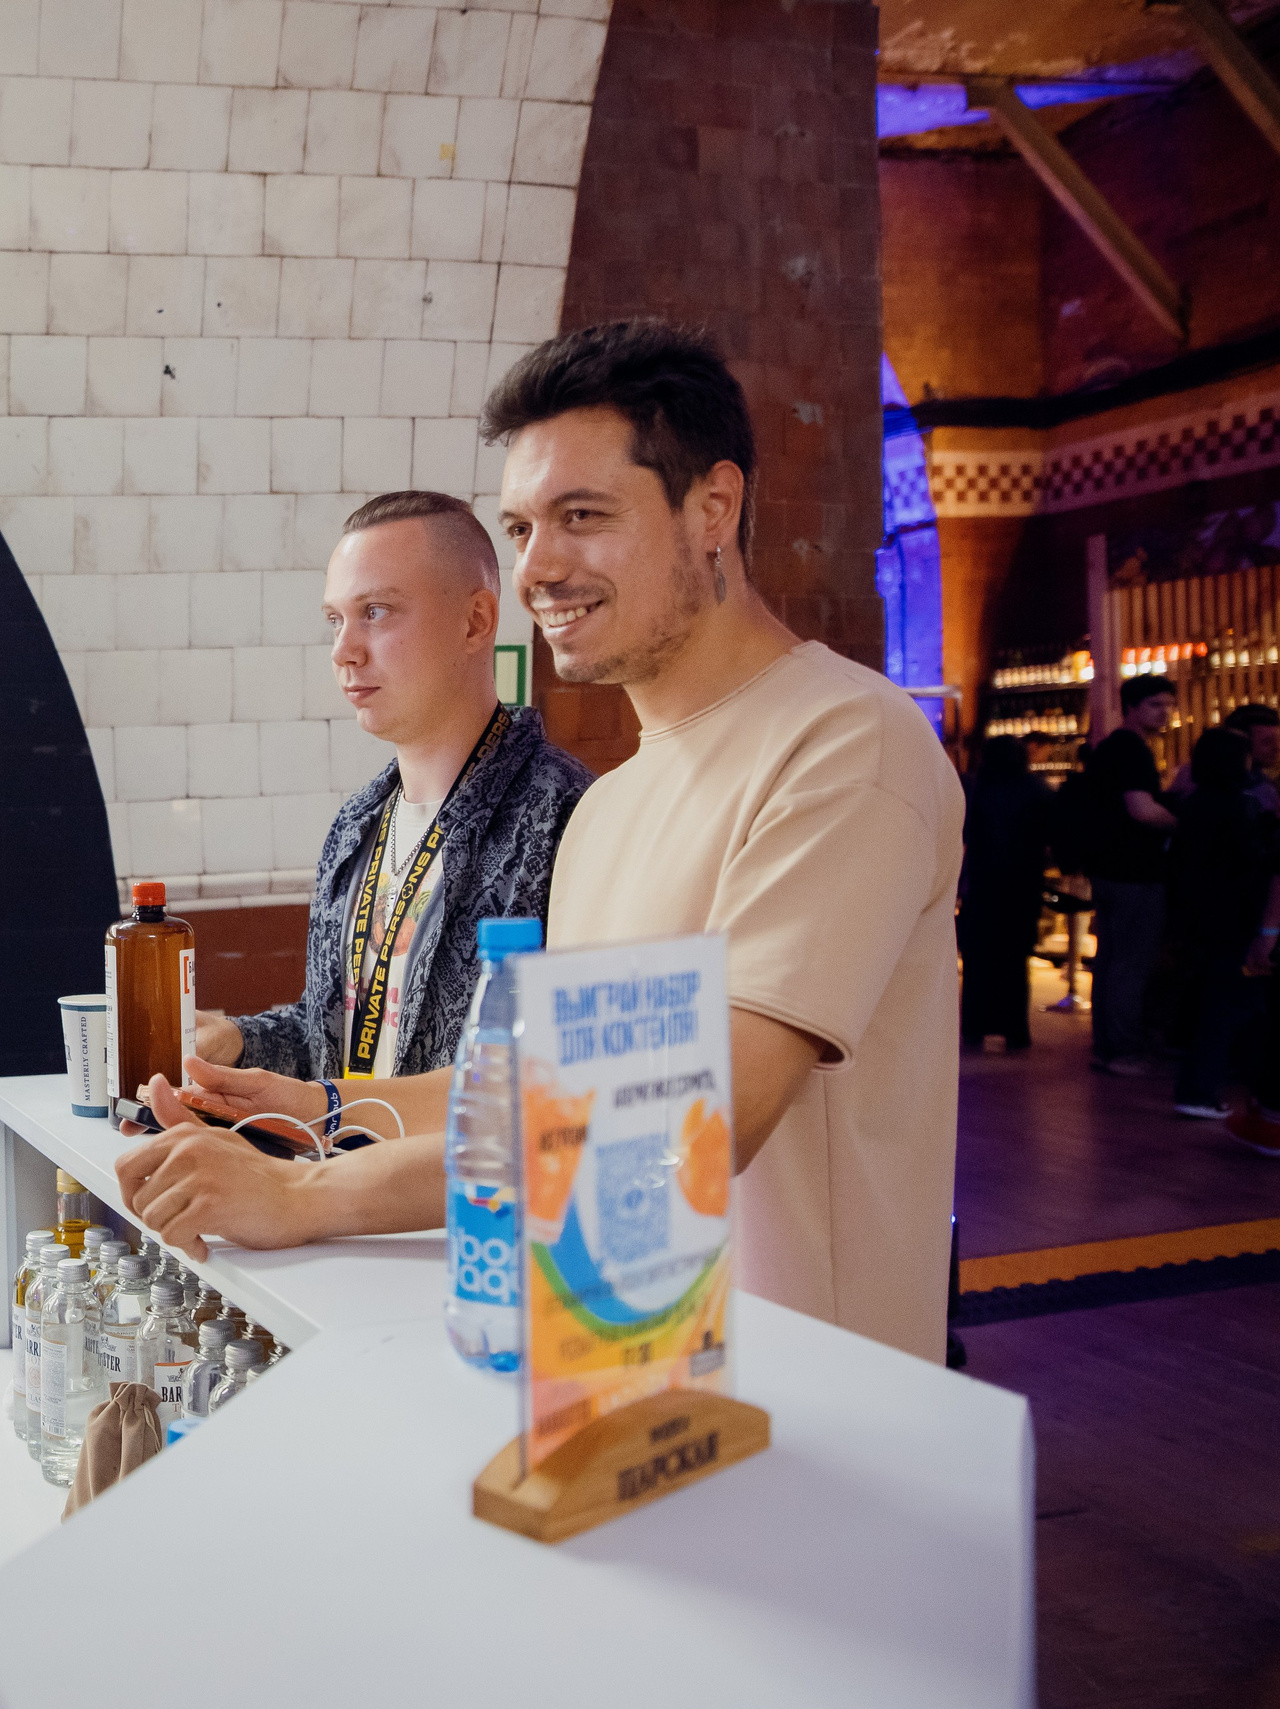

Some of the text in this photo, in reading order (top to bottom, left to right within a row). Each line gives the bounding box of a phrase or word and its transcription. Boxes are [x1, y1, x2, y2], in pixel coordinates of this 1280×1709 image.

[356, 845, 382, 932] PRIVATE
[357, 965, 385, 1058] PRIVATE
[379, 852, 431, 961] PERSONS
[80, 1016, 91, 1101] MASTERLY CRAFTED
